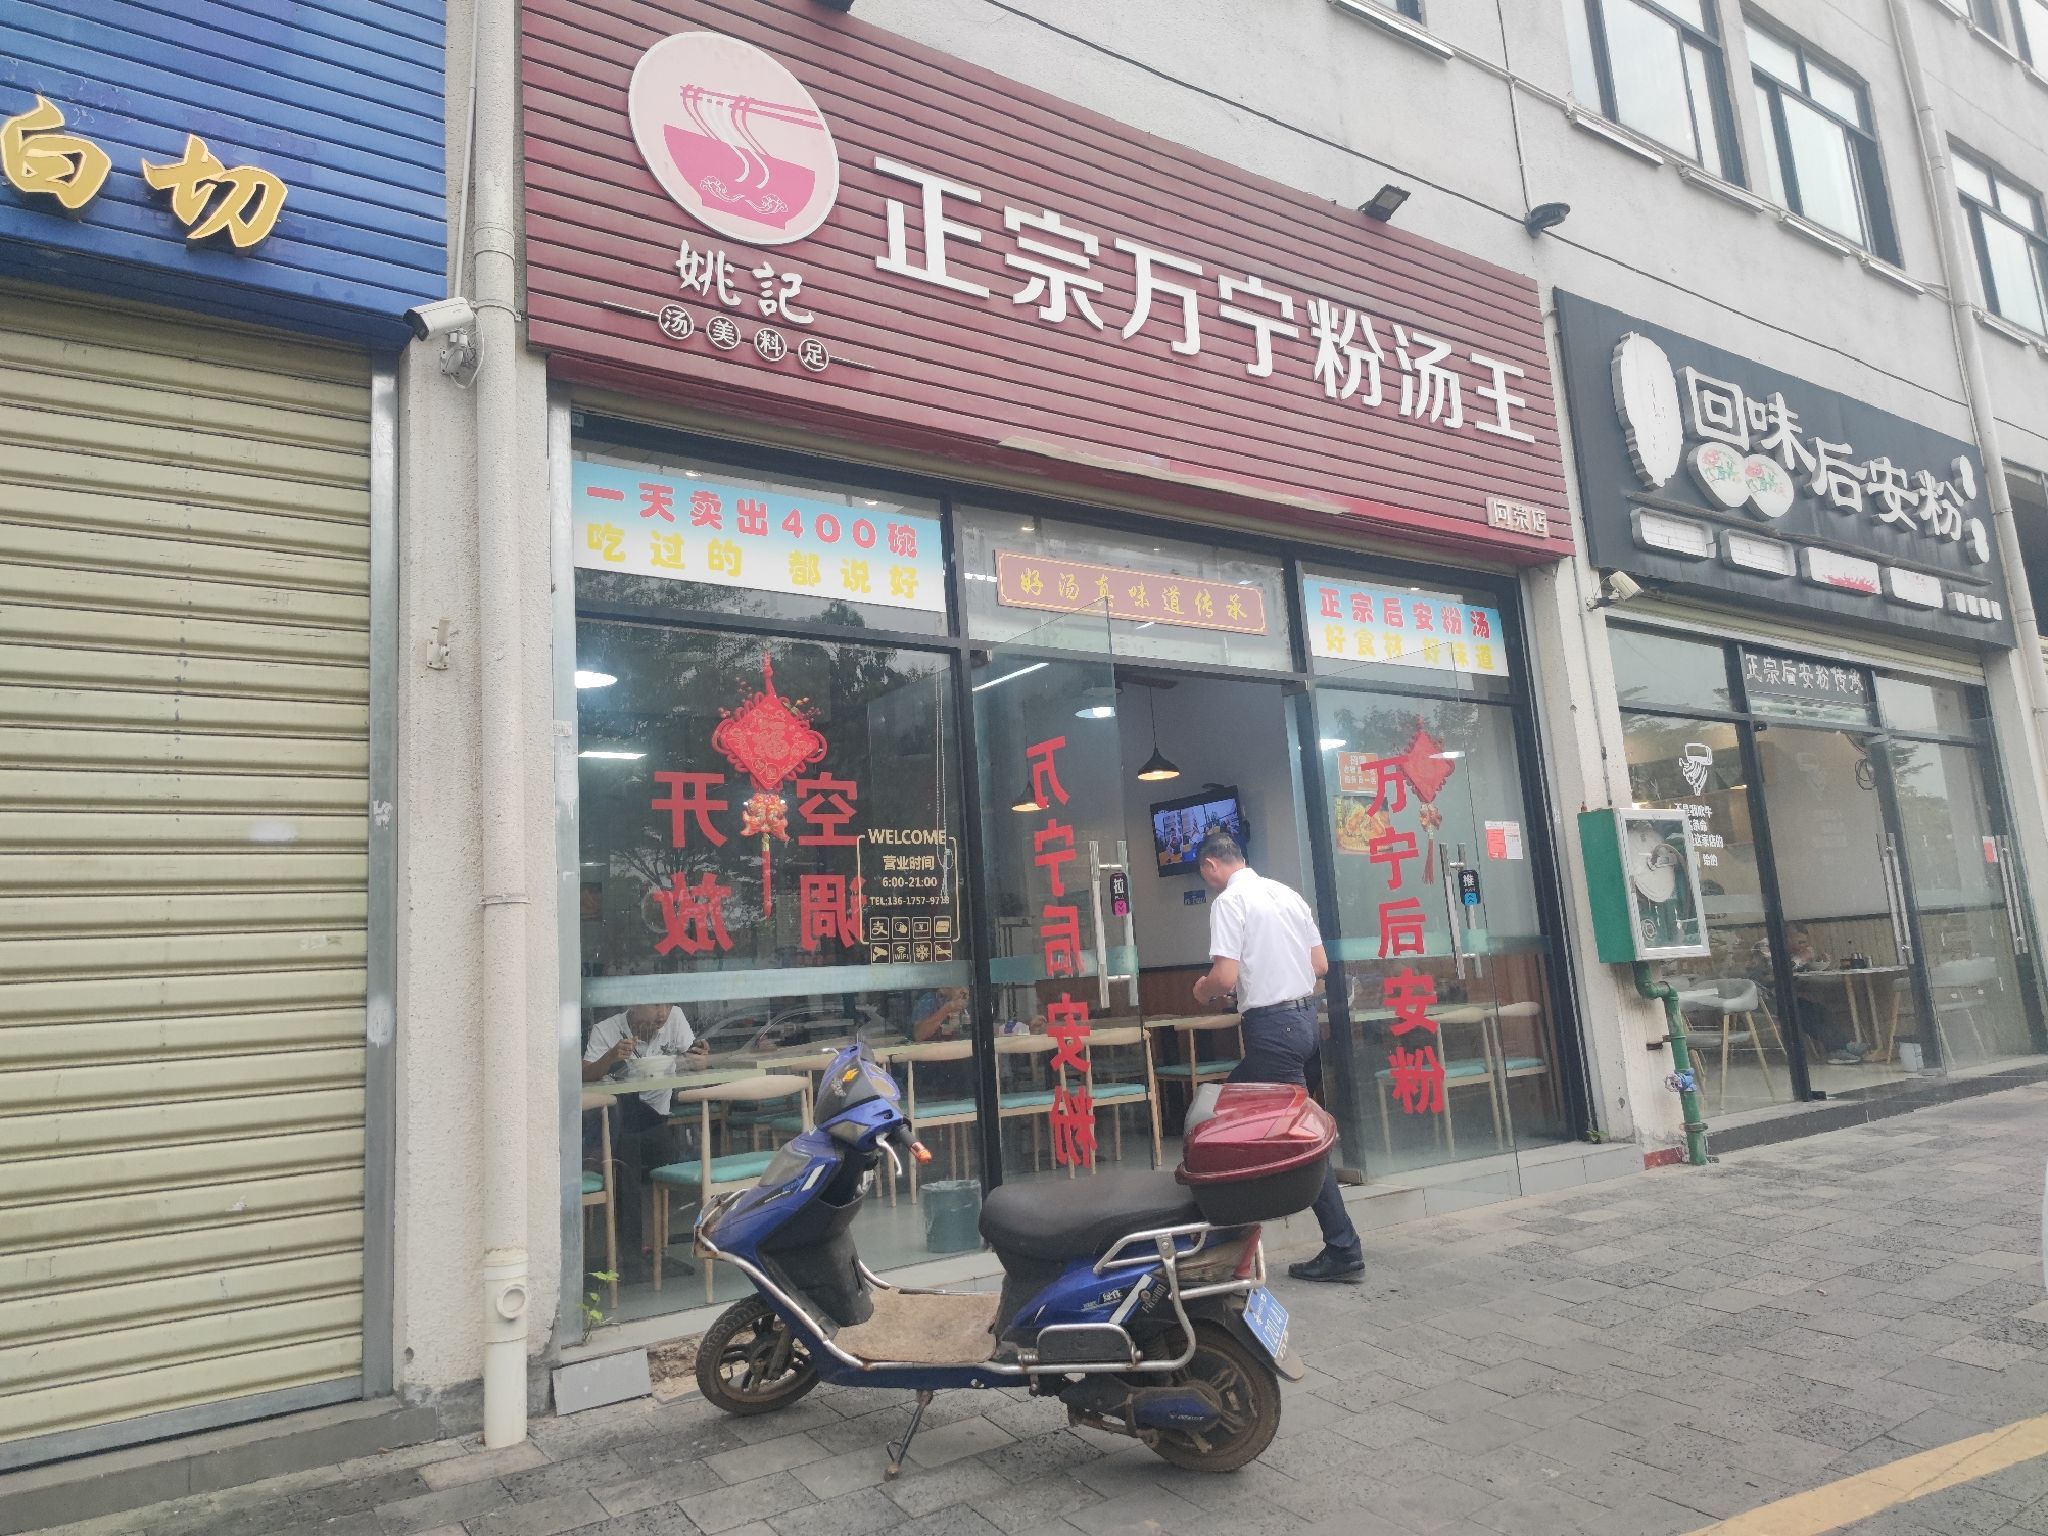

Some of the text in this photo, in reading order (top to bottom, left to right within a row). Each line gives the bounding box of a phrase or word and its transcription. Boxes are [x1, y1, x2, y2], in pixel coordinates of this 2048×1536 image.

[1, 93, 288, 248] 白切
[675, 239, 815, 324] 姚記
[873, 155, 1536, 444] 正宗万宁粉汤王
[658, 304, 830, 372] 汤美料足
[1681, 365, 1964, 541] 回味后安粉
[1319, 587, 1490, 639] 正宗后安粉汤
[868, 829, 946, 845] WELCOME
[883, 855, 935, 871] 营业时间
[882, 876, 938, 888] 6:00-21:00
[1114, 878, 1124, 894] 拉
[1463, 874, 1474, 886] 推
[1360, 754, 1446, 1115] 万宁后安粉
